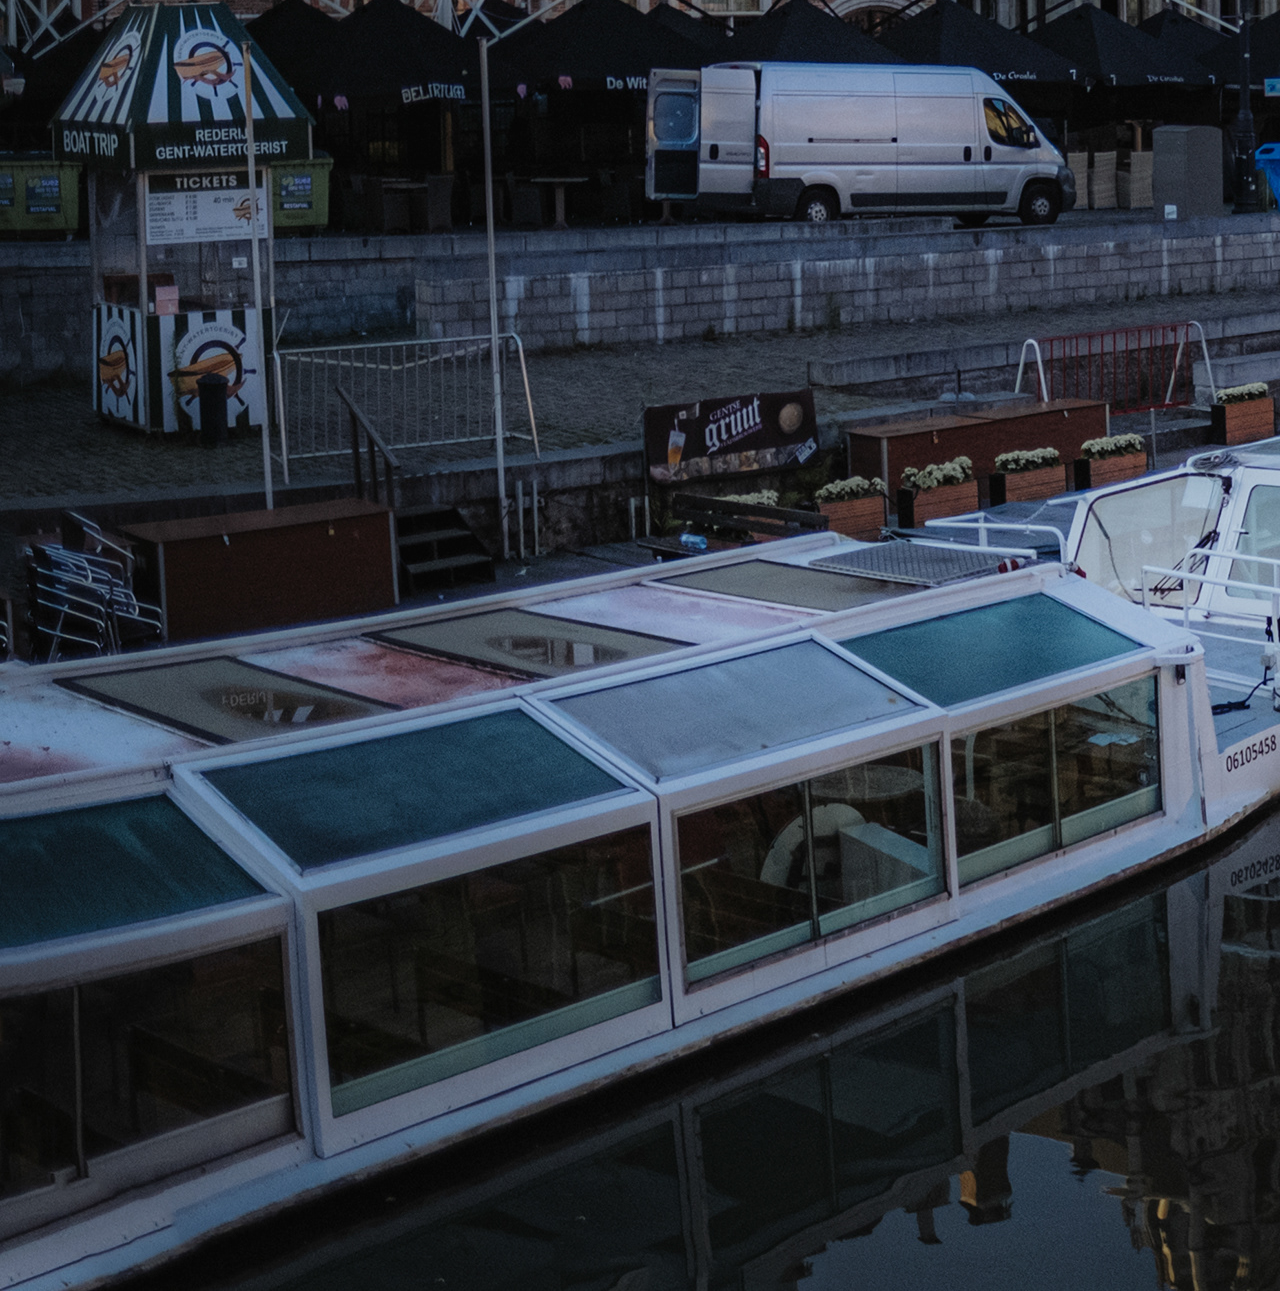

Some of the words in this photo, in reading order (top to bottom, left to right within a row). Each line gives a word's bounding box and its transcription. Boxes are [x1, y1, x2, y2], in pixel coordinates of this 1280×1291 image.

[401, 83, 466, 104] DELIRIUM
[606, 76, 624, 90] De
[63, 130, 92, 154] BOAT
[93, 132, 119, 157] TRIP
[195, 127, 248, 143] REDERIJ
[175, 175, 238, 189] TICKETS
[213, 196, 221, 204] 40
[222, 196, 235, 204] min
[709, 399, 742, 421] GENTSE
[704, 395, 763, 456] gruut
[1226, 734, 1277, 773] 06105458
